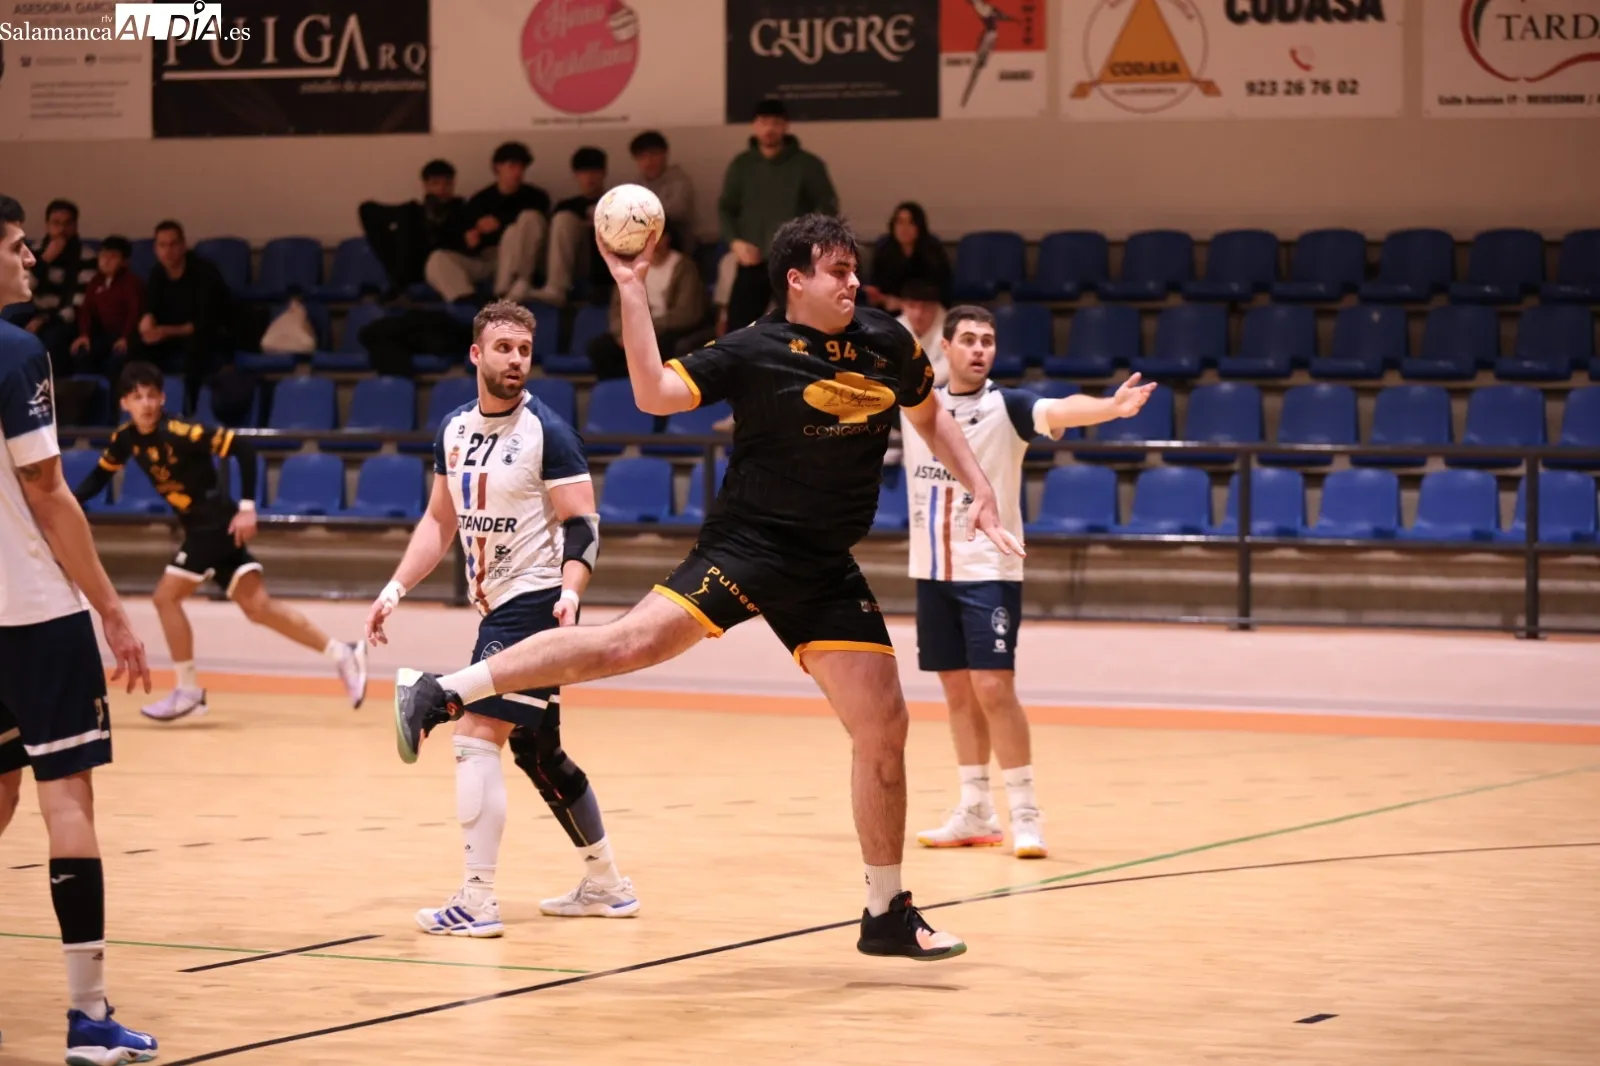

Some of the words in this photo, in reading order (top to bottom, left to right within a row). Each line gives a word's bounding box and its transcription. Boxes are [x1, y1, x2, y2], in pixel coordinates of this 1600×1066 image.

[1496, 14, 1600, 41] TARD
[1108, 61, 1180, 78] CODASA
[1245, 80, 1278, 97] 923
[1283, 80, 1305, 96] 26
[1310, 79, 1332, 95] 76
[1337, 79, 1359, 95] 02
[825, 341, 858, 361] 94
[463, 432, 499, 467] 27
